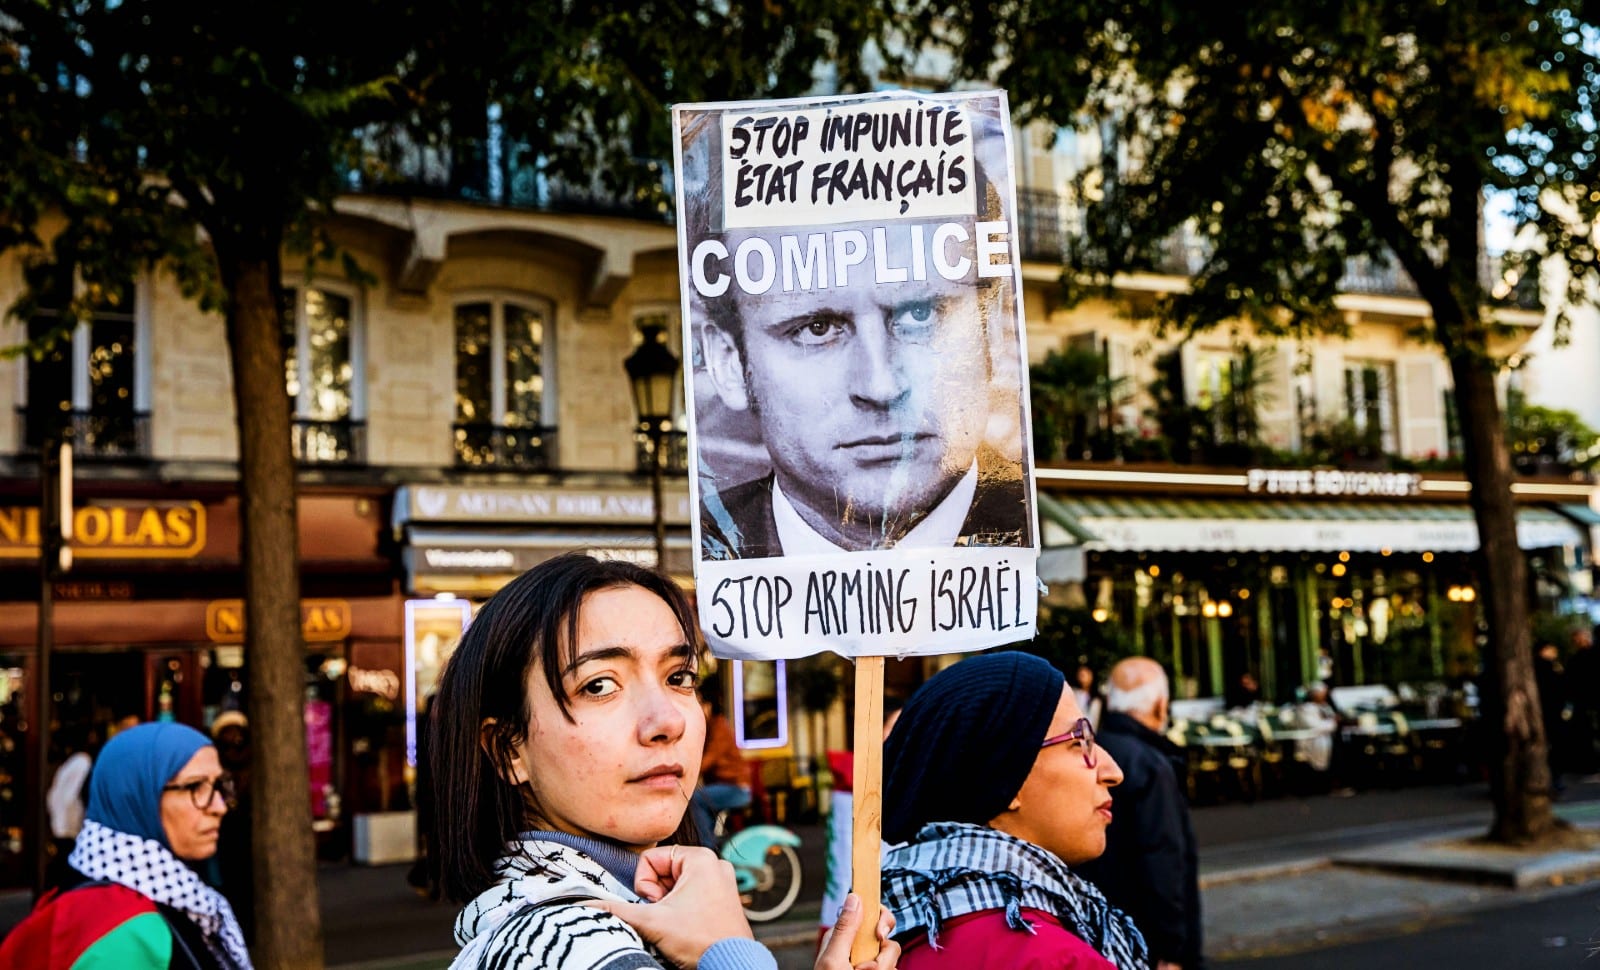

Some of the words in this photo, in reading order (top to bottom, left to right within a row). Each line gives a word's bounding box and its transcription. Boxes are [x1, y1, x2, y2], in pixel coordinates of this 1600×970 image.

[730, 116, 809, 159] STOP
[735, 159, 804, 207] ÉTAT
[811, 150, 966, 215] FRANÇAIS
[691, 221, 1012, 297] COMPLICE
[0, 505, 192, 546] NIOLAS
[712, 575, 792, 639] STOP
[804, 562, 918, 636] ARMING
[929, 559, 1028, 633] ISRAËL
